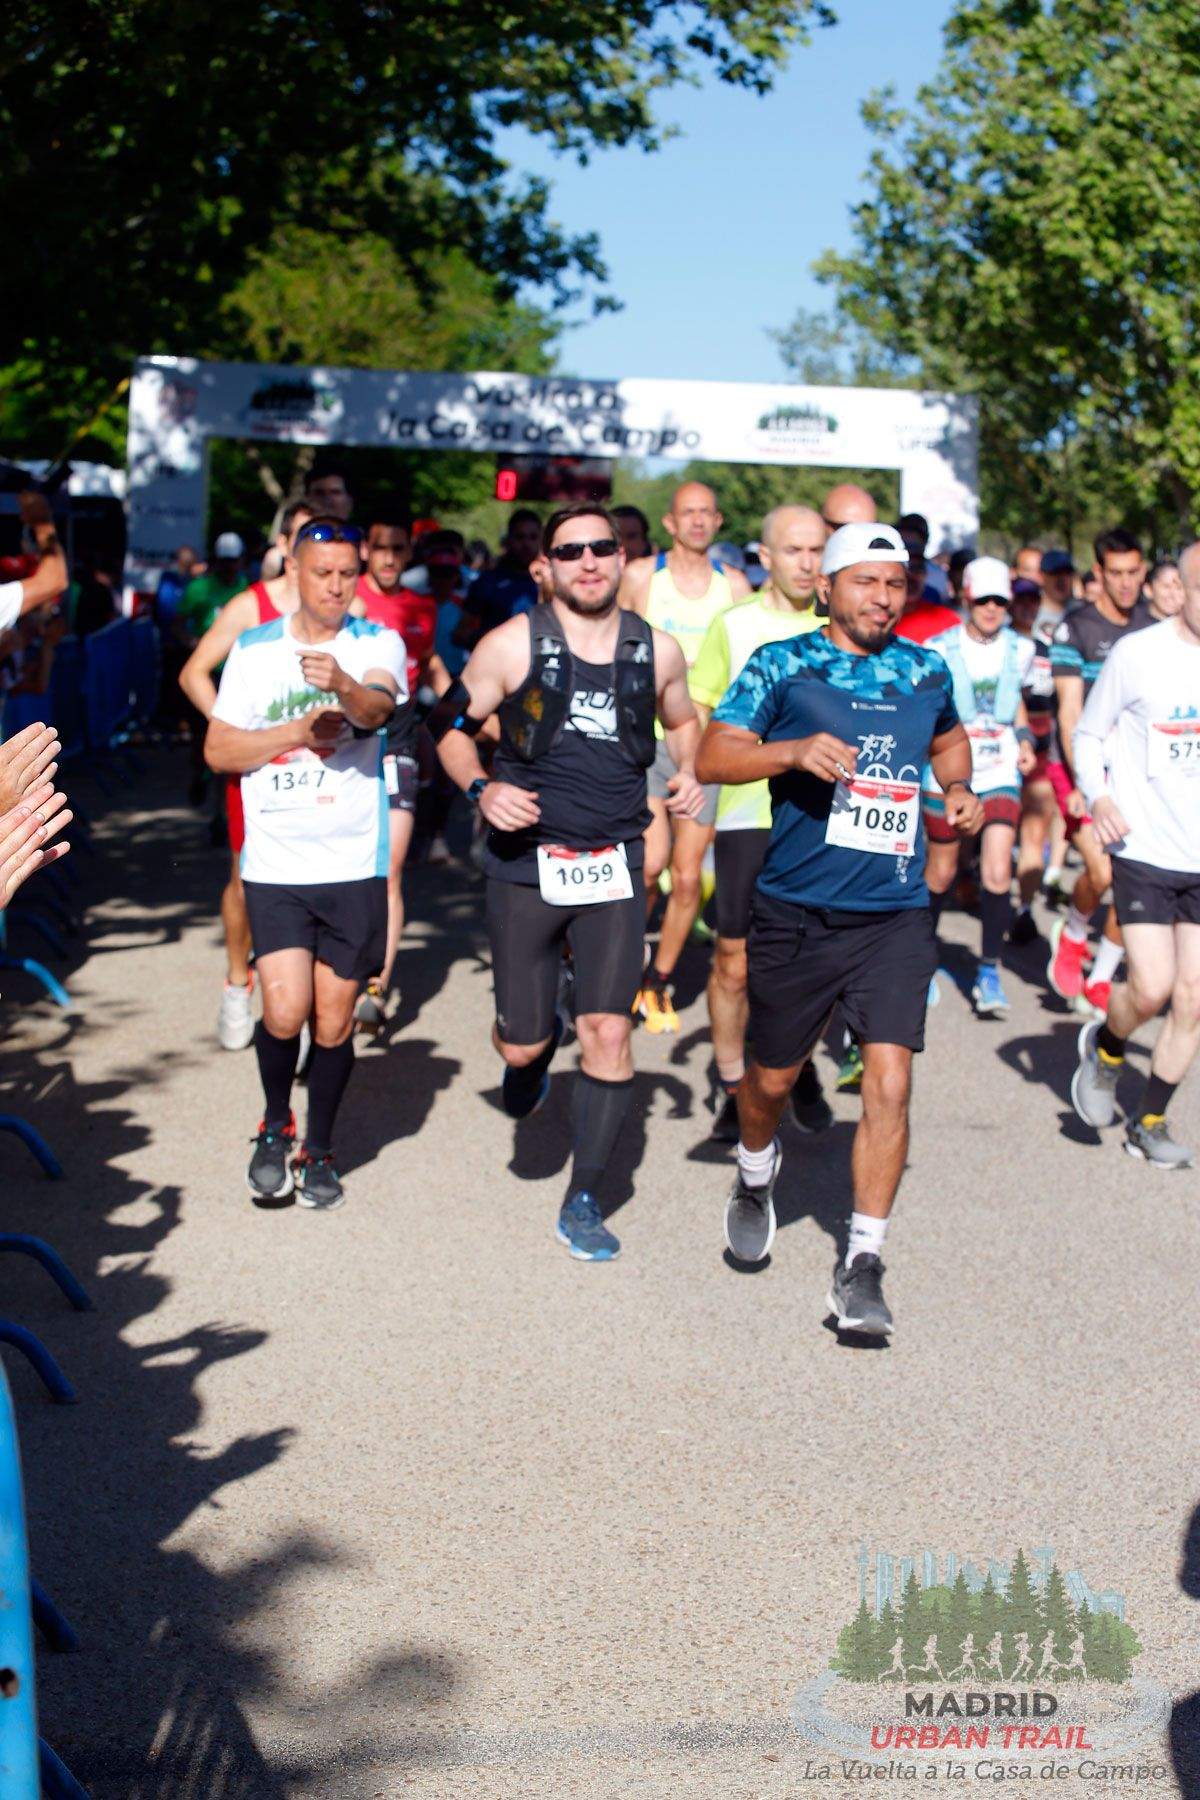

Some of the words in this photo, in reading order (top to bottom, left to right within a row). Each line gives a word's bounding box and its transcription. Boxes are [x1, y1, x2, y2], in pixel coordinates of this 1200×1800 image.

[271, 770, 325, 791] 1347
[850, 805, 908, 833] 1088
[556, 863, 613, 886] 1059
